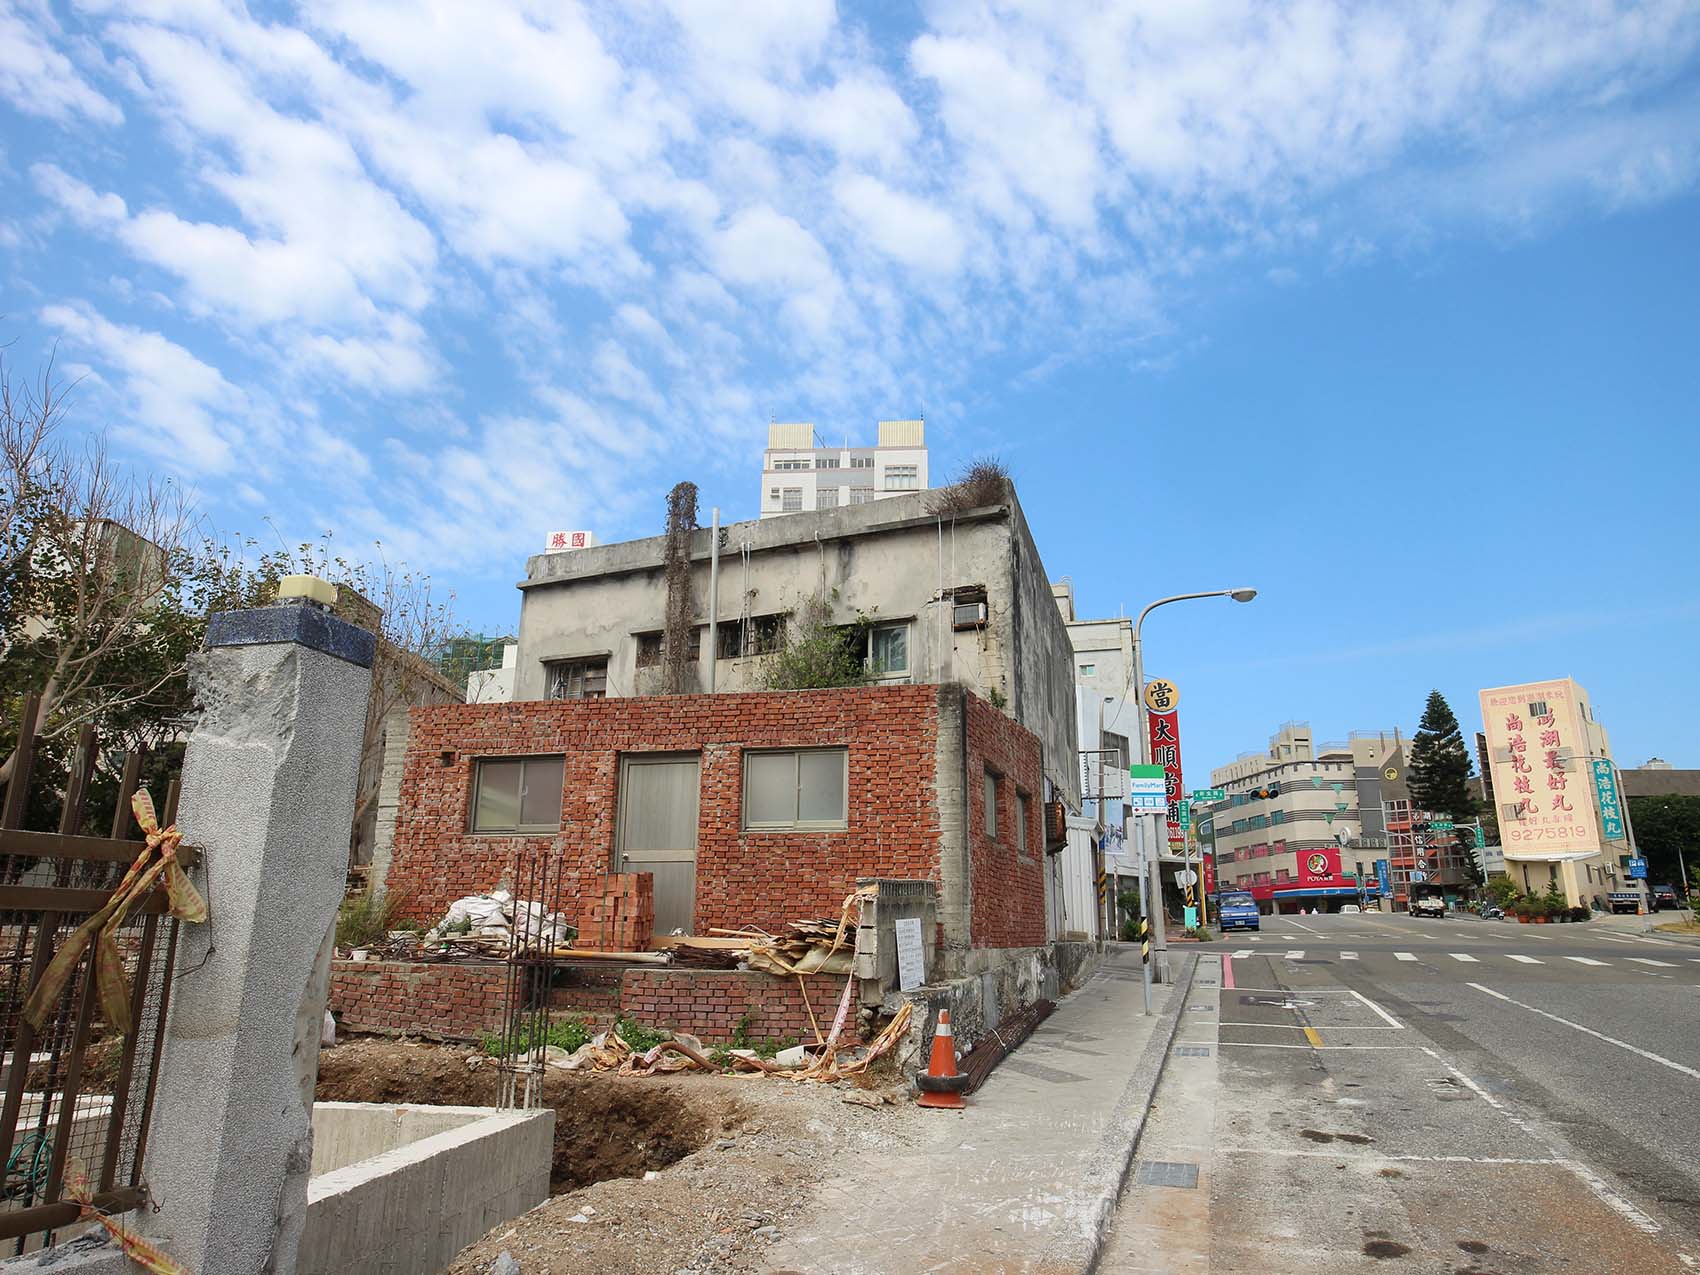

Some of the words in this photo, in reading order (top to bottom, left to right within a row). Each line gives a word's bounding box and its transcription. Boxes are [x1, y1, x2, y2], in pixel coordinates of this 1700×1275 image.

[551, 532, 586, 549] 勝國
[1150, 682, 1173, 708] 當
[1131, 781, 1164, 790] FamilyMart
[1511, 825, 1586, 841] 9275819
